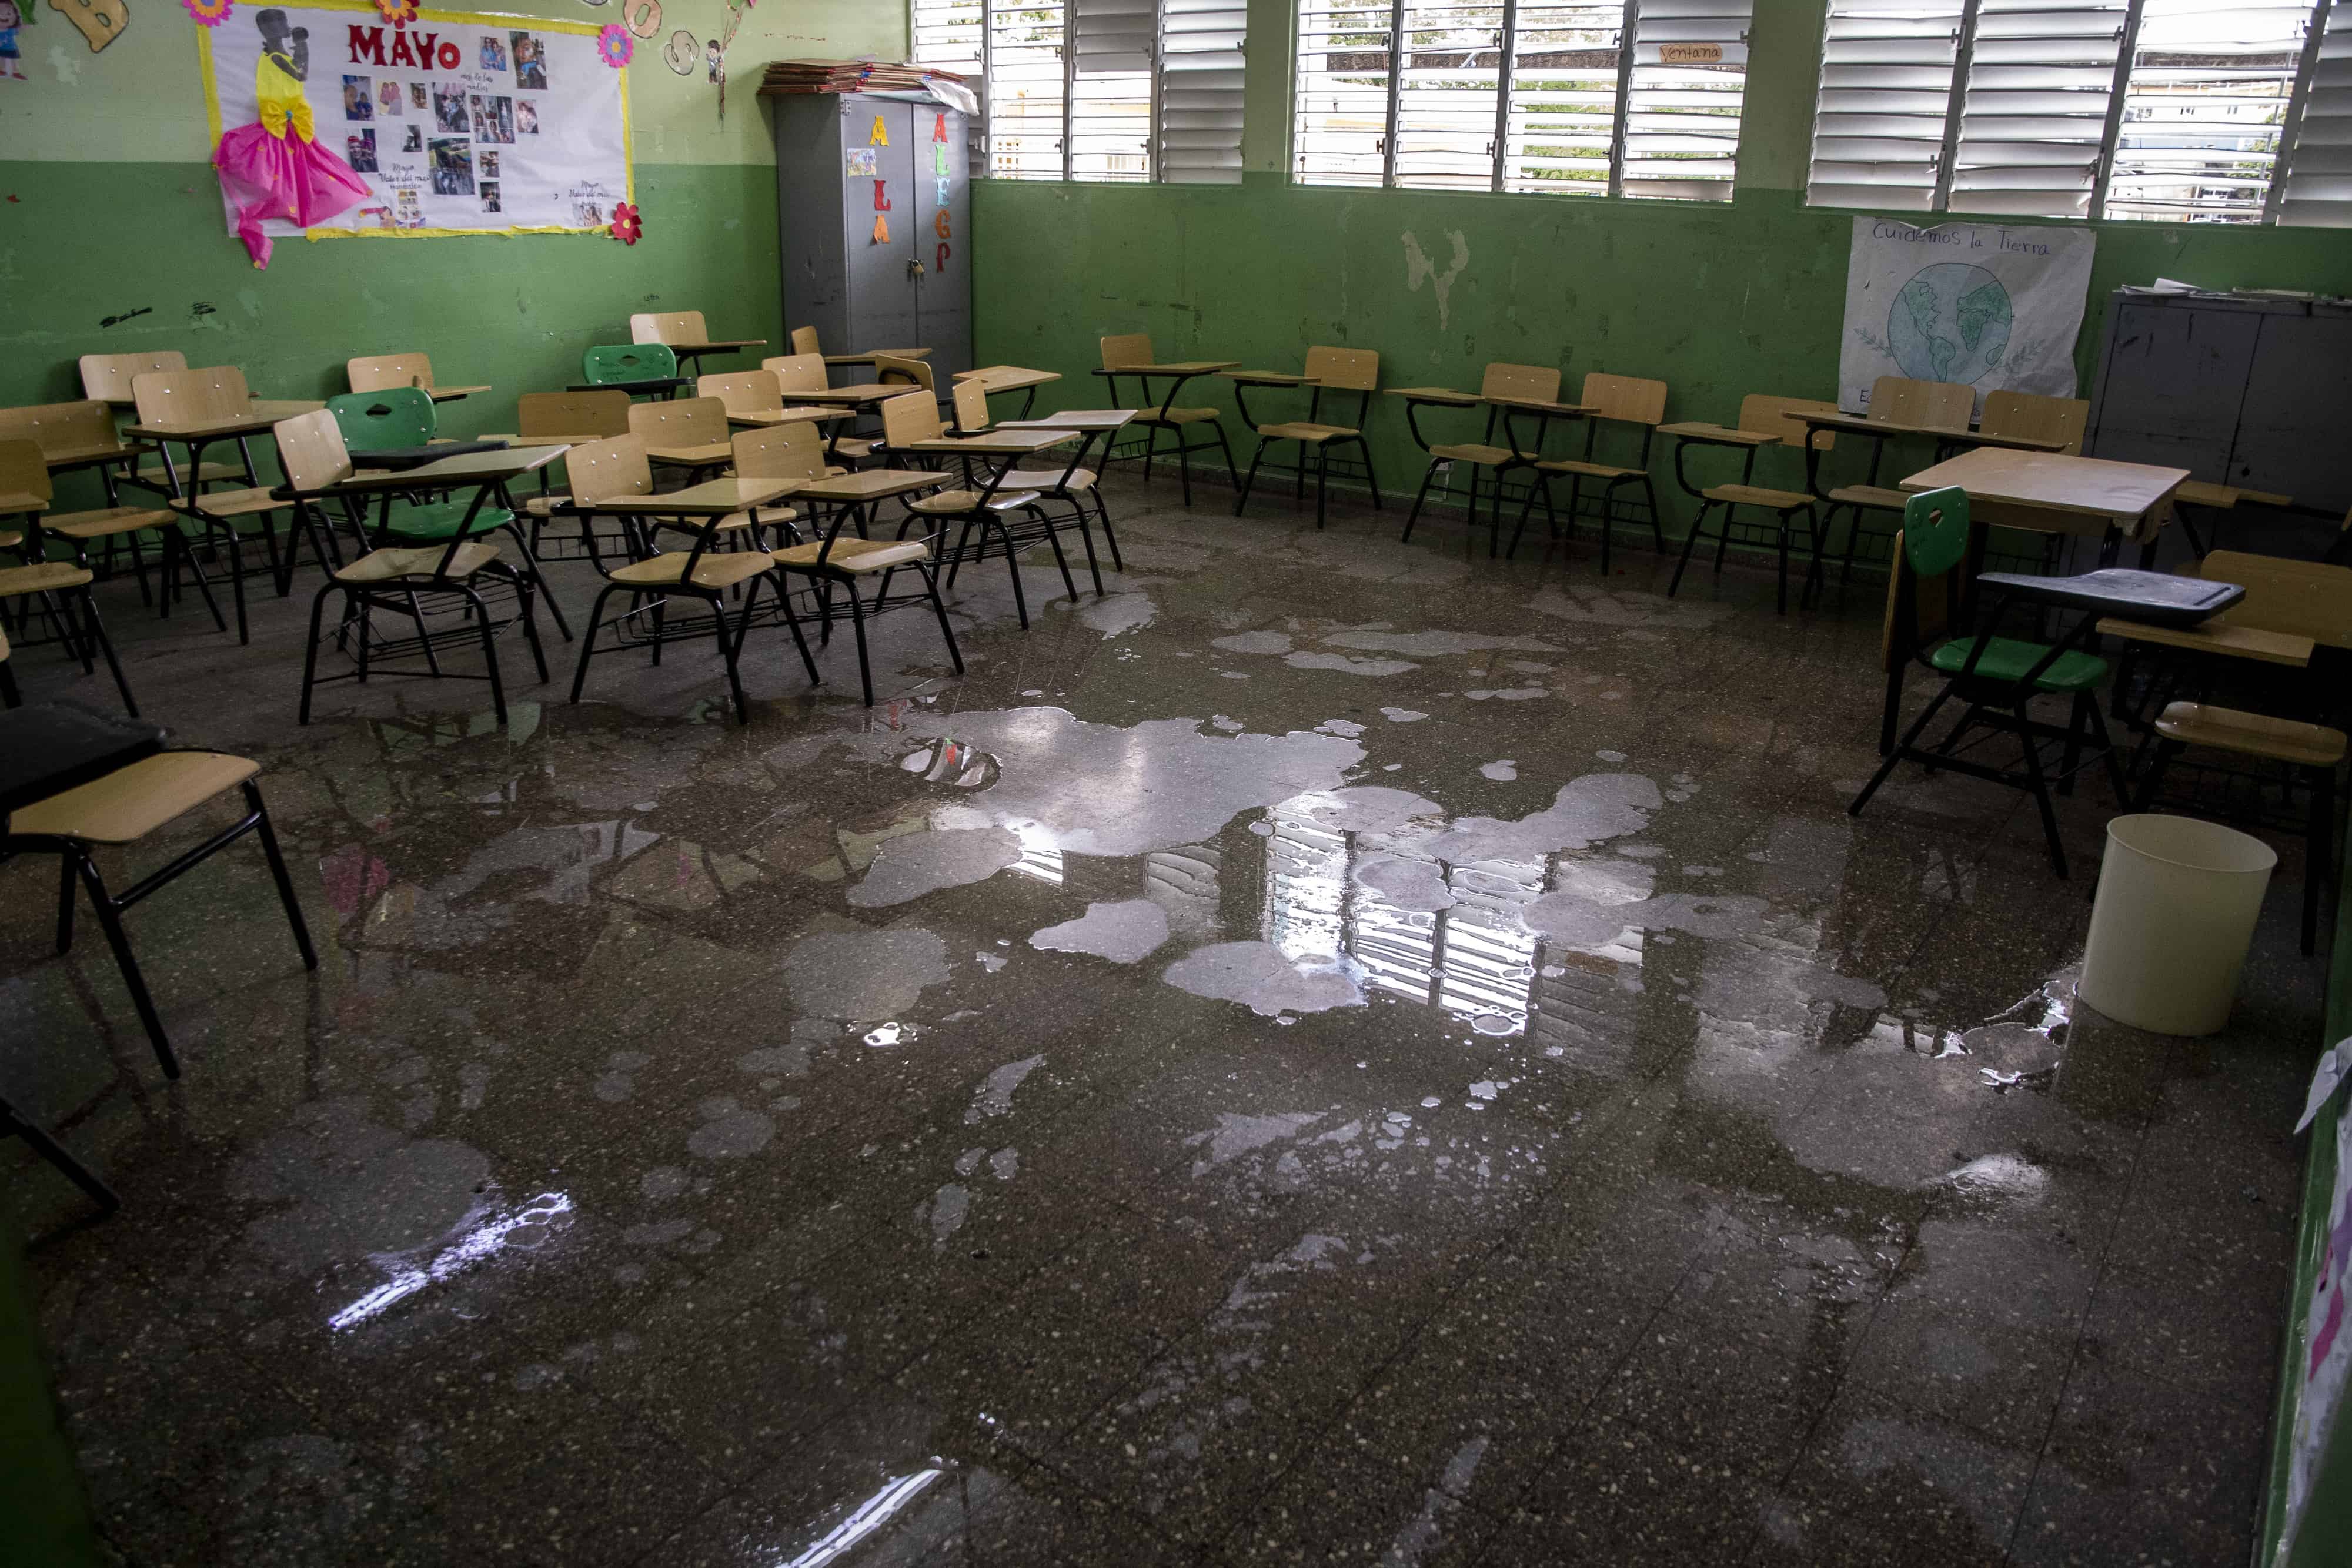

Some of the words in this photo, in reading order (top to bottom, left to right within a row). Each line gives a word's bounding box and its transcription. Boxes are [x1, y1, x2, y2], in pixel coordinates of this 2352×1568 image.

[348, 25, 461, 70] MAYO
[1659, 45, 1720, 62] Ventana
[1873, 222, 1961, 246] Cuidemos
[1970, 230, 1983, 249] la
[1999, 229, 2050, 256] Tierra
